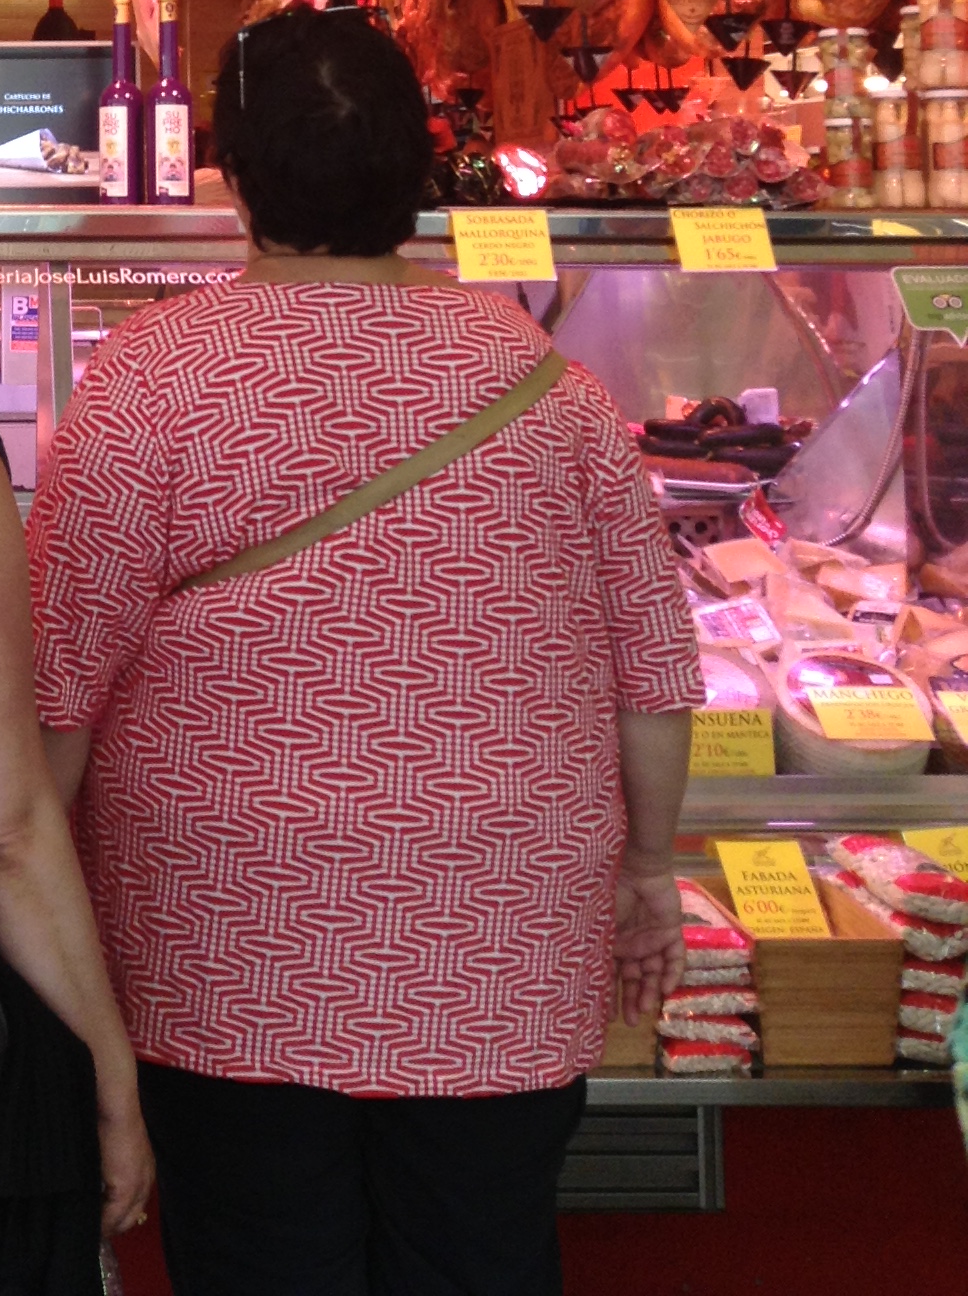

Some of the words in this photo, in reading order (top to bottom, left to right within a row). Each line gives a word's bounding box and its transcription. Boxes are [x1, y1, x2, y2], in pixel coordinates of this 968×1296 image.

[813, 688, 914, 701] MANCHEGO
[693, 710, 762, 726] NSUEÑA
[741, 870, 798, 882] FABADA
[735, 885, 812, 896] ASTURIANA
